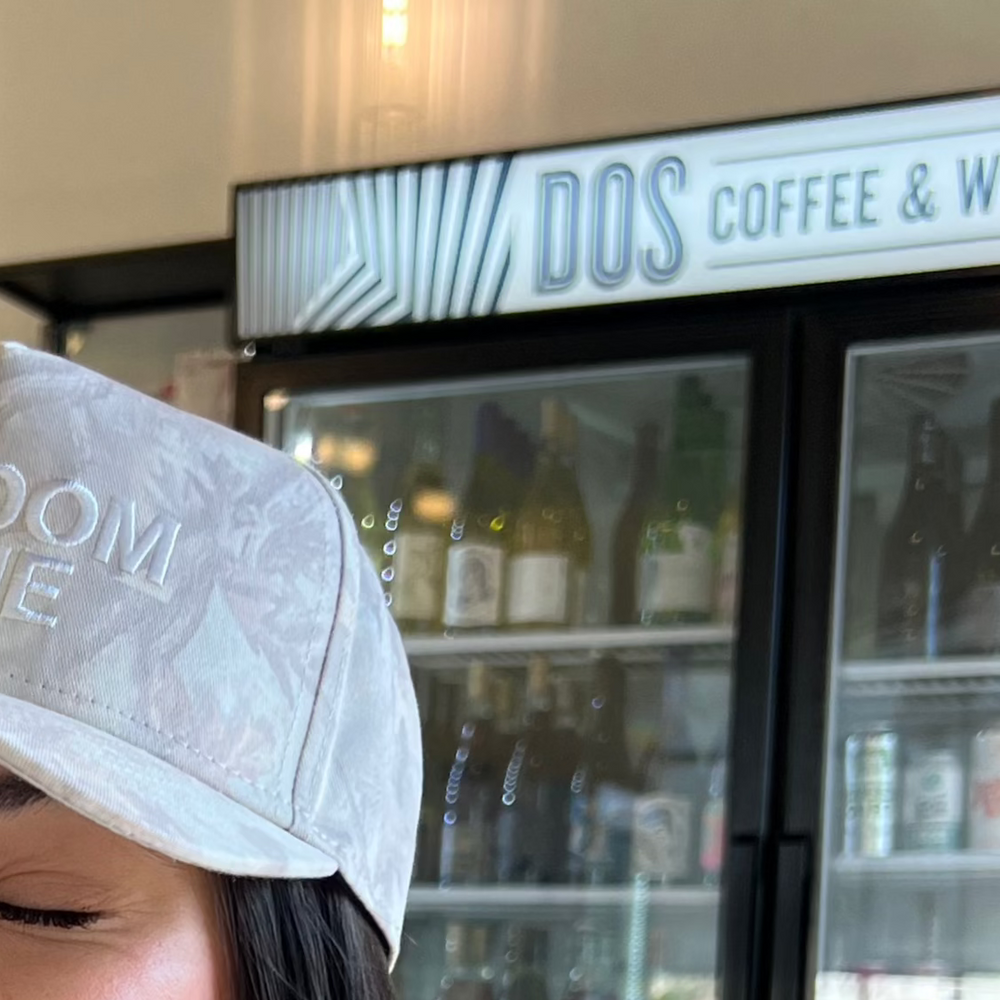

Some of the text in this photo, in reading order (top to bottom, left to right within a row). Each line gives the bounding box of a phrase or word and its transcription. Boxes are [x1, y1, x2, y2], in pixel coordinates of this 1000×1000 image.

[537, 156, 687, 295] DOS
[710, 168, 880, 242] COFFEE
[902, 162, 936, 221] &
